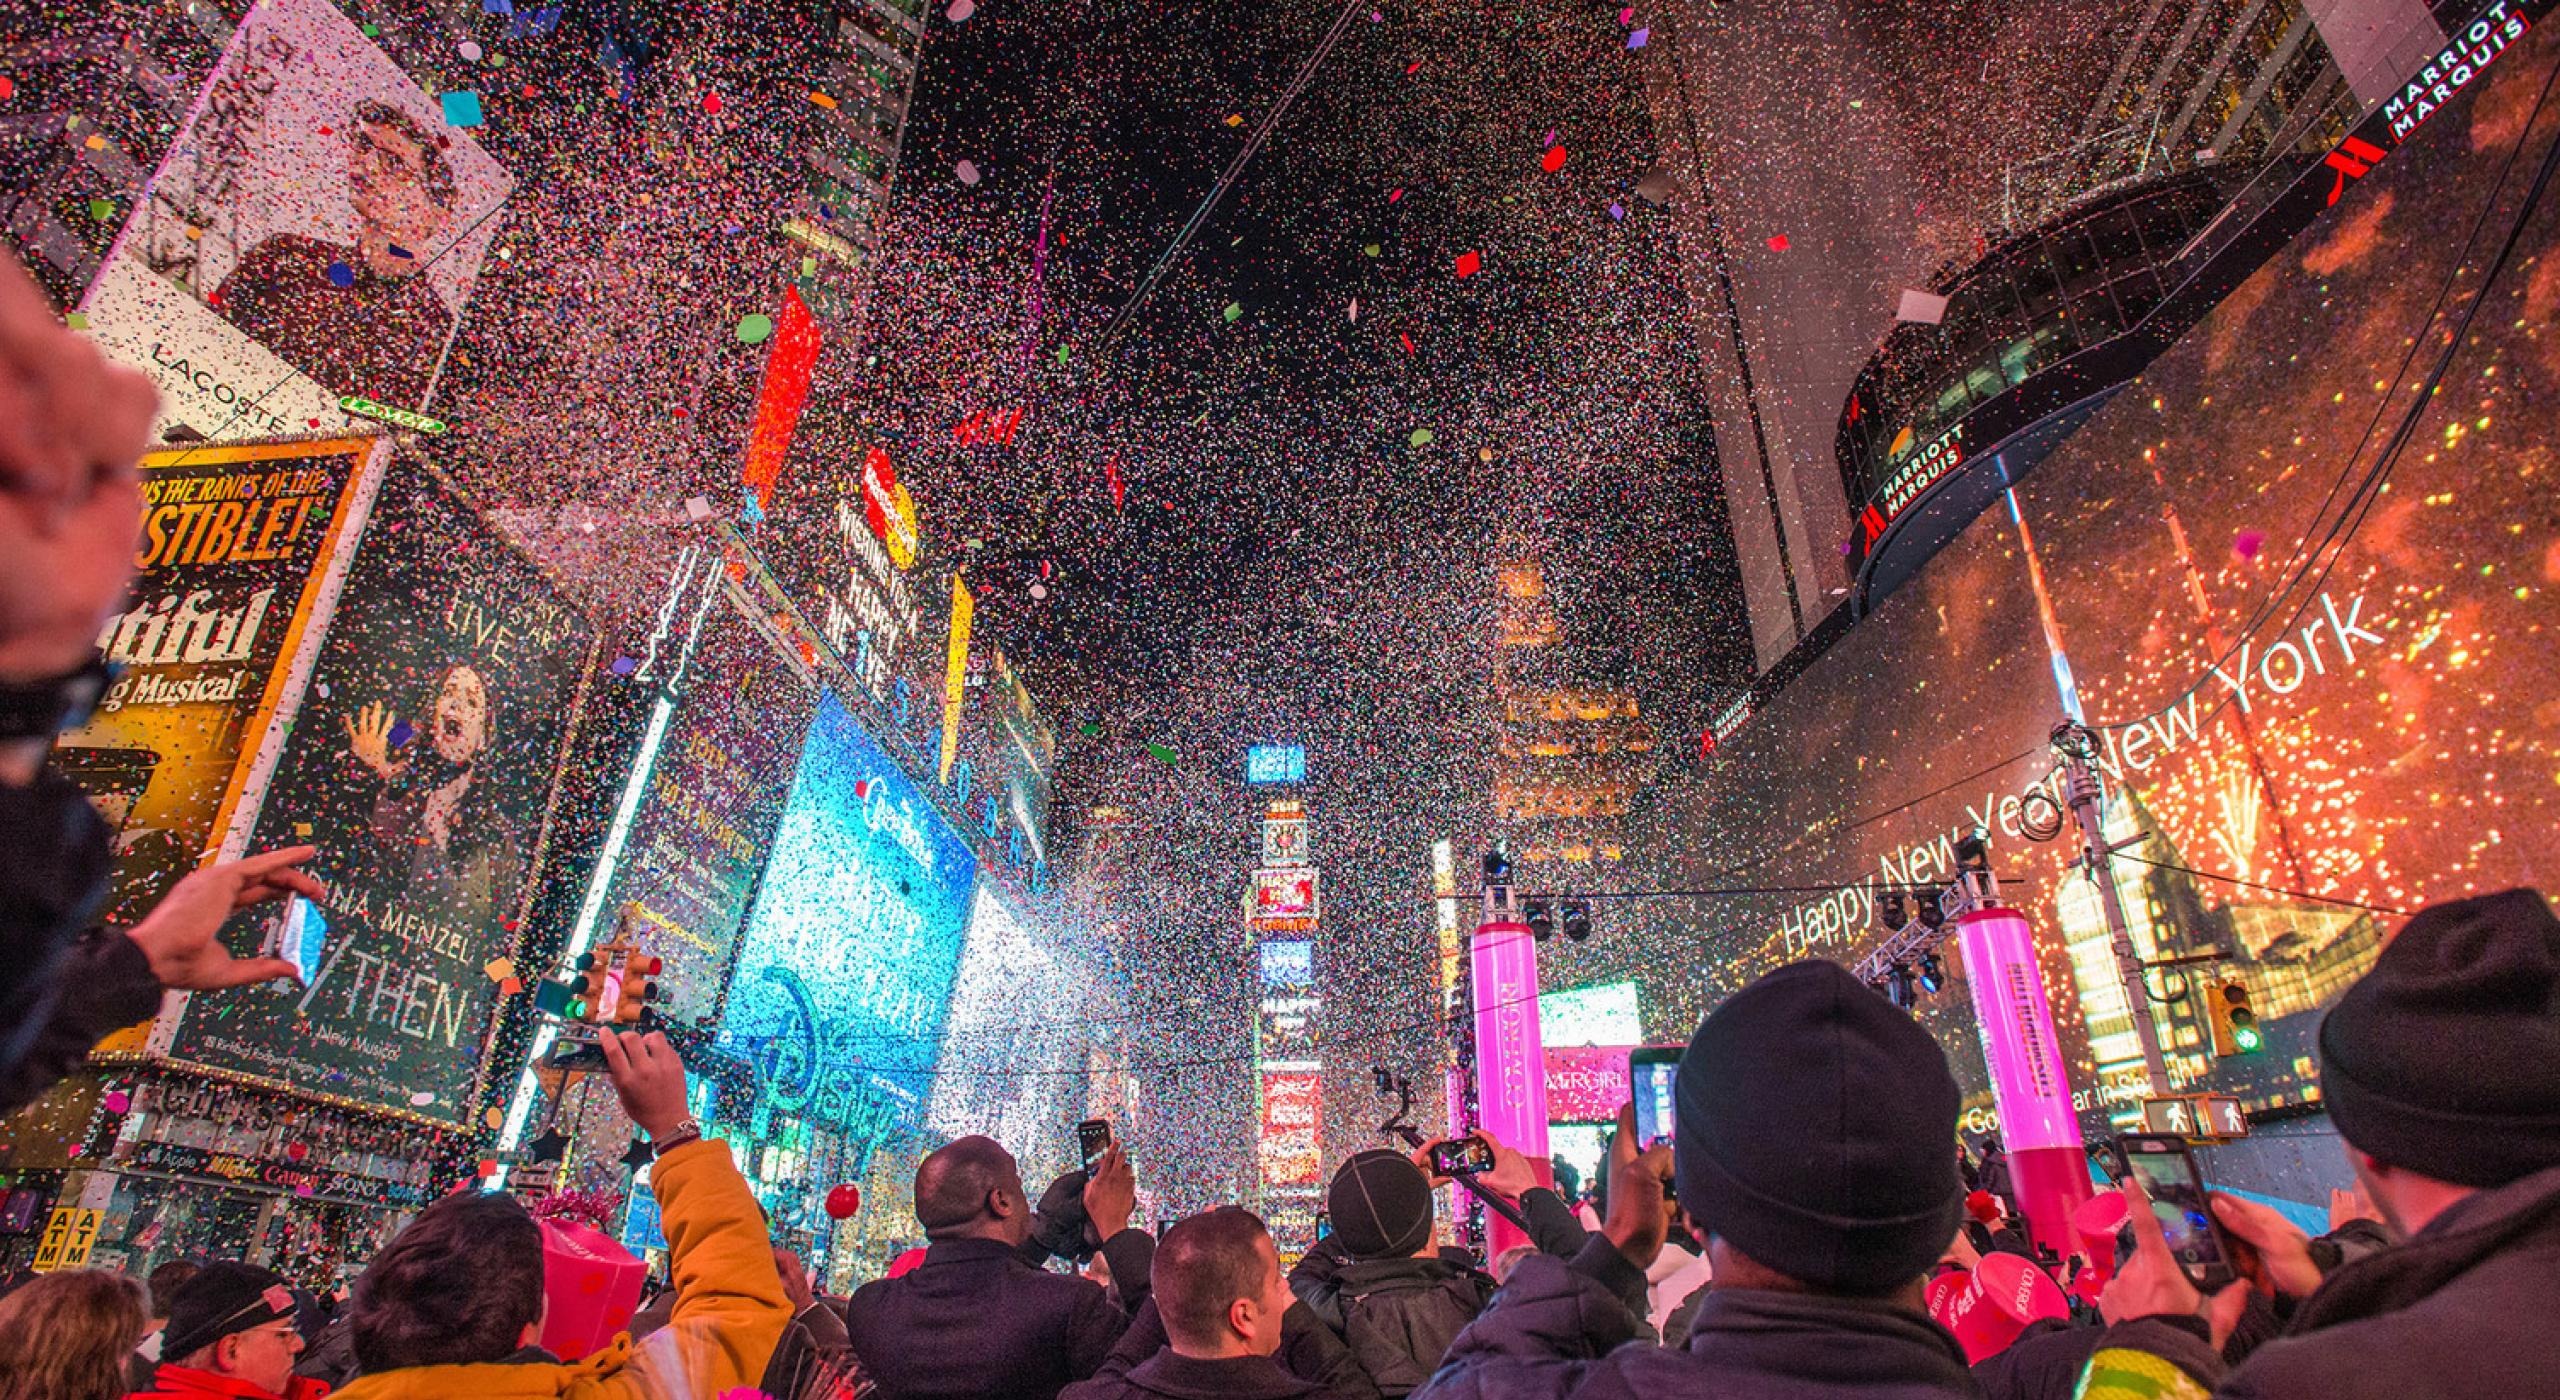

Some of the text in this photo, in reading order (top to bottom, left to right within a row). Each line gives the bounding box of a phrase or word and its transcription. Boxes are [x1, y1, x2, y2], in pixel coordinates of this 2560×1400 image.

[2384, 0, 2525, 121] MARRIOT
[2391, 18, 2524, 139] MARQUIS
[149, 342, 286, 436] LACOSTE
[200, 474, 262, 502] RANKS
[262, 472, 292, 497] OF
[1883, 424, 1965, 498] MARRIOTT
[1887, 447, 1960, 517] MARQUIS
[442, 590, 518, 668] LIVE
[130, 668, 245, 705] Musical
[1783, 593, 2385, 955] Happy New Year New York
[379, 900, 475, 966] MENZEL
[1253, 918, 1320, 931] TOSHIBA
[1544, 1070, 1628, 1091] VERGIRL
[161, 1149, 197, 1171] Apple
[331, 1174, 383, 1197] SONY
[39, 1211, 68, 1263] ATM
[66, 1208, 95, 1265] ATM
